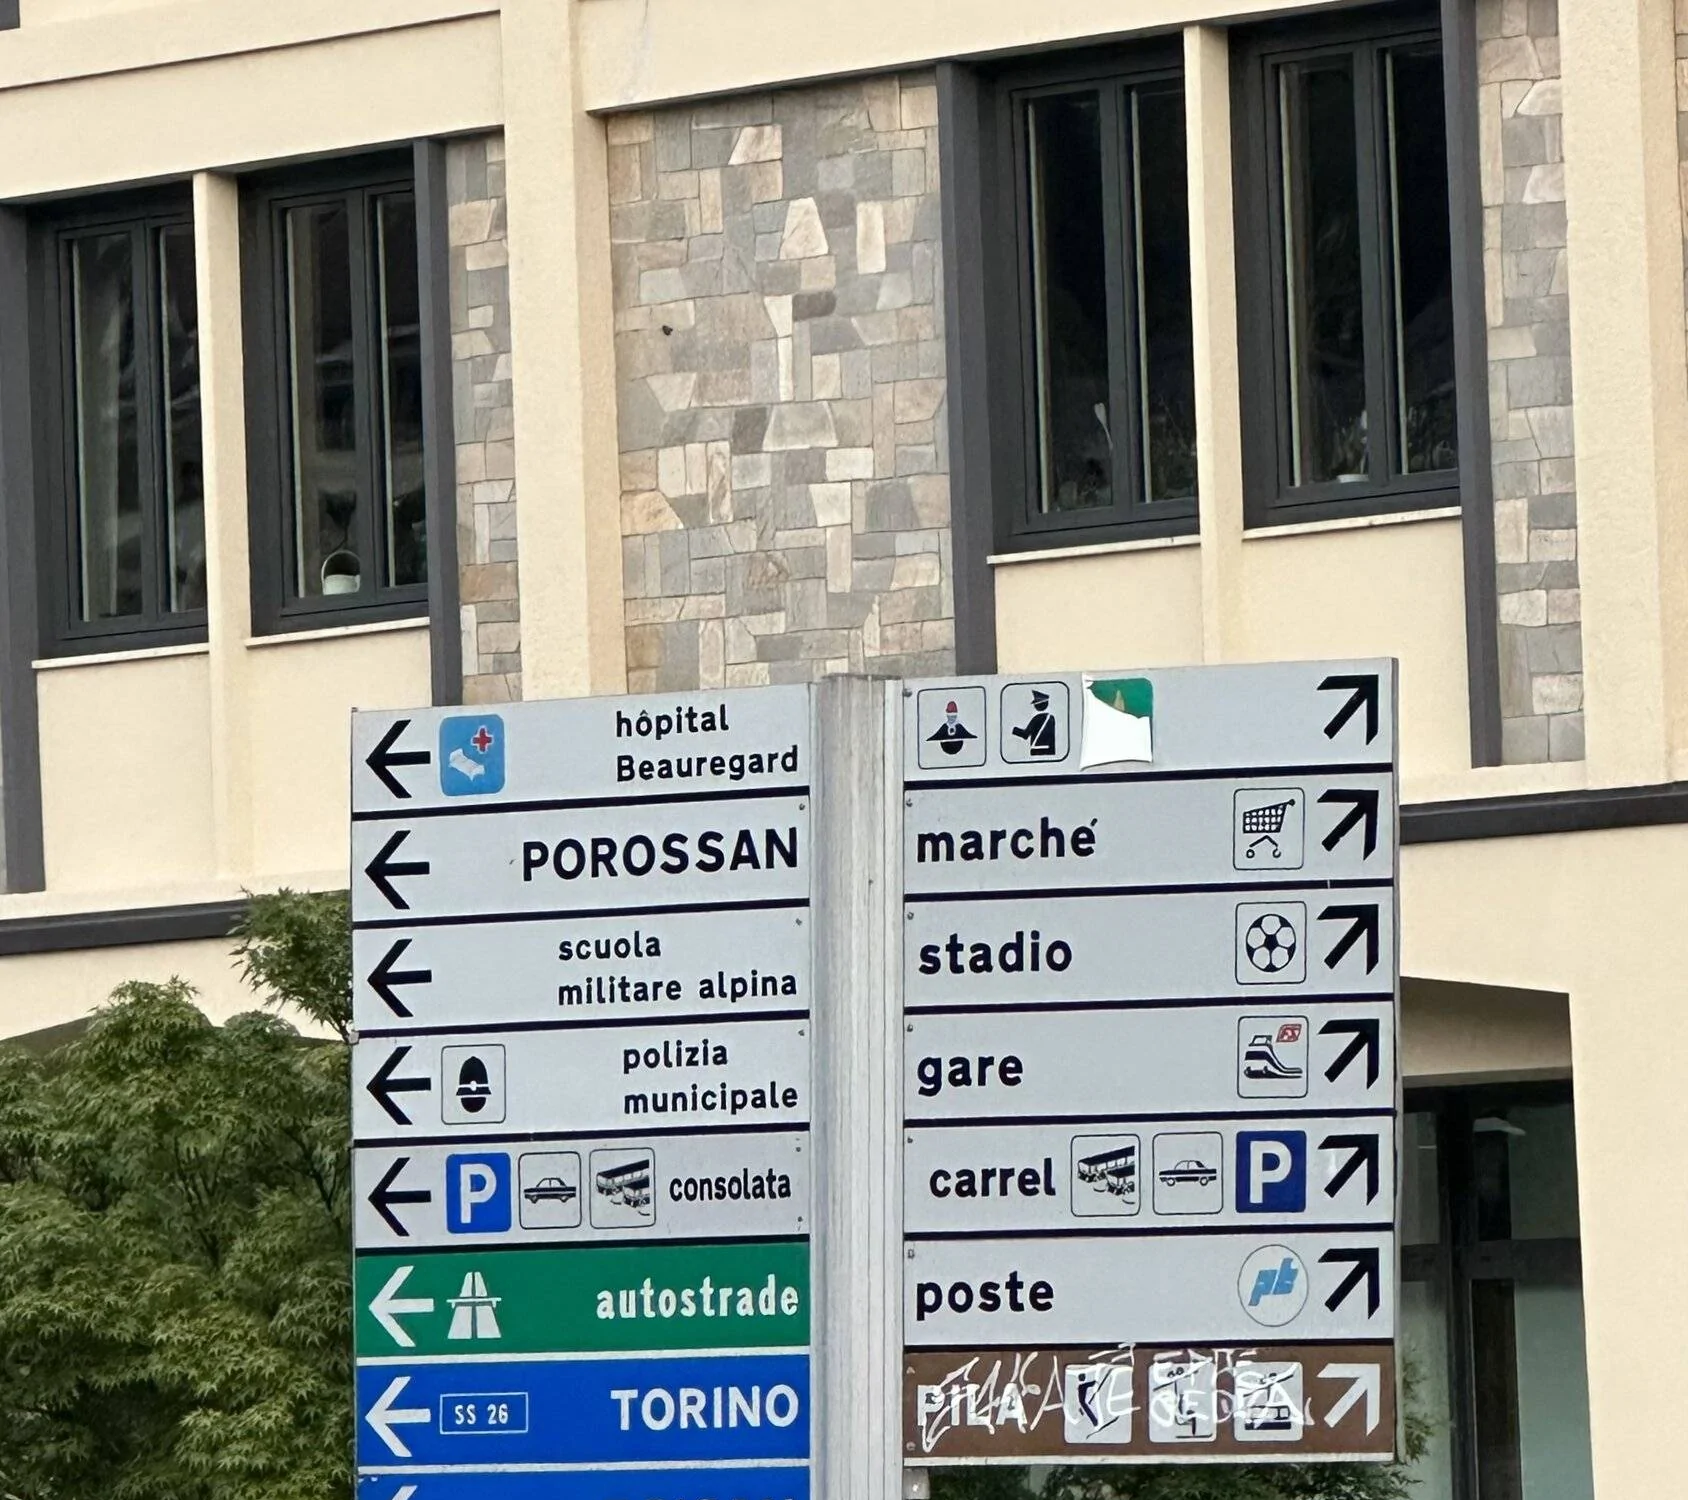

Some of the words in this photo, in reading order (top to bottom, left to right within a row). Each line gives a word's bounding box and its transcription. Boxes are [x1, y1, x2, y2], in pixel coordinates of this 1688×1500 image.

[616, 703, 730, 740] hôpital
[616, 744, 799, 782] Beauregard
[523, 826, 799, 882] POROSSAN
[917, 816, 1098, 863] marché
[558, 930, 662, 961] scuola
[918, 929, 1073, 975] stadio
[558, 975, 682, 1006] militare
[698, 969, 797, 1004] alpina
[623, 1038, 728, 1075] polizia
[917, 1055, 1024, 1097] gare
[624, 1080, 798, 1116] municipale
[669, 1167, 792, 1202] consolata
[929, 1157, 1057, 1199] carrel
[1249, 1140, 1292, 1204] P
[460, 1163, 497, 1224] P
[596, 1273, 799, 1320] autostrade
[916, 1270, 1054, 1322] poste
[454, 1403, 477, 1425] SS
[487, 1403, 509, 1425] 26
[610, 1384, 800, 1431] TORINO
